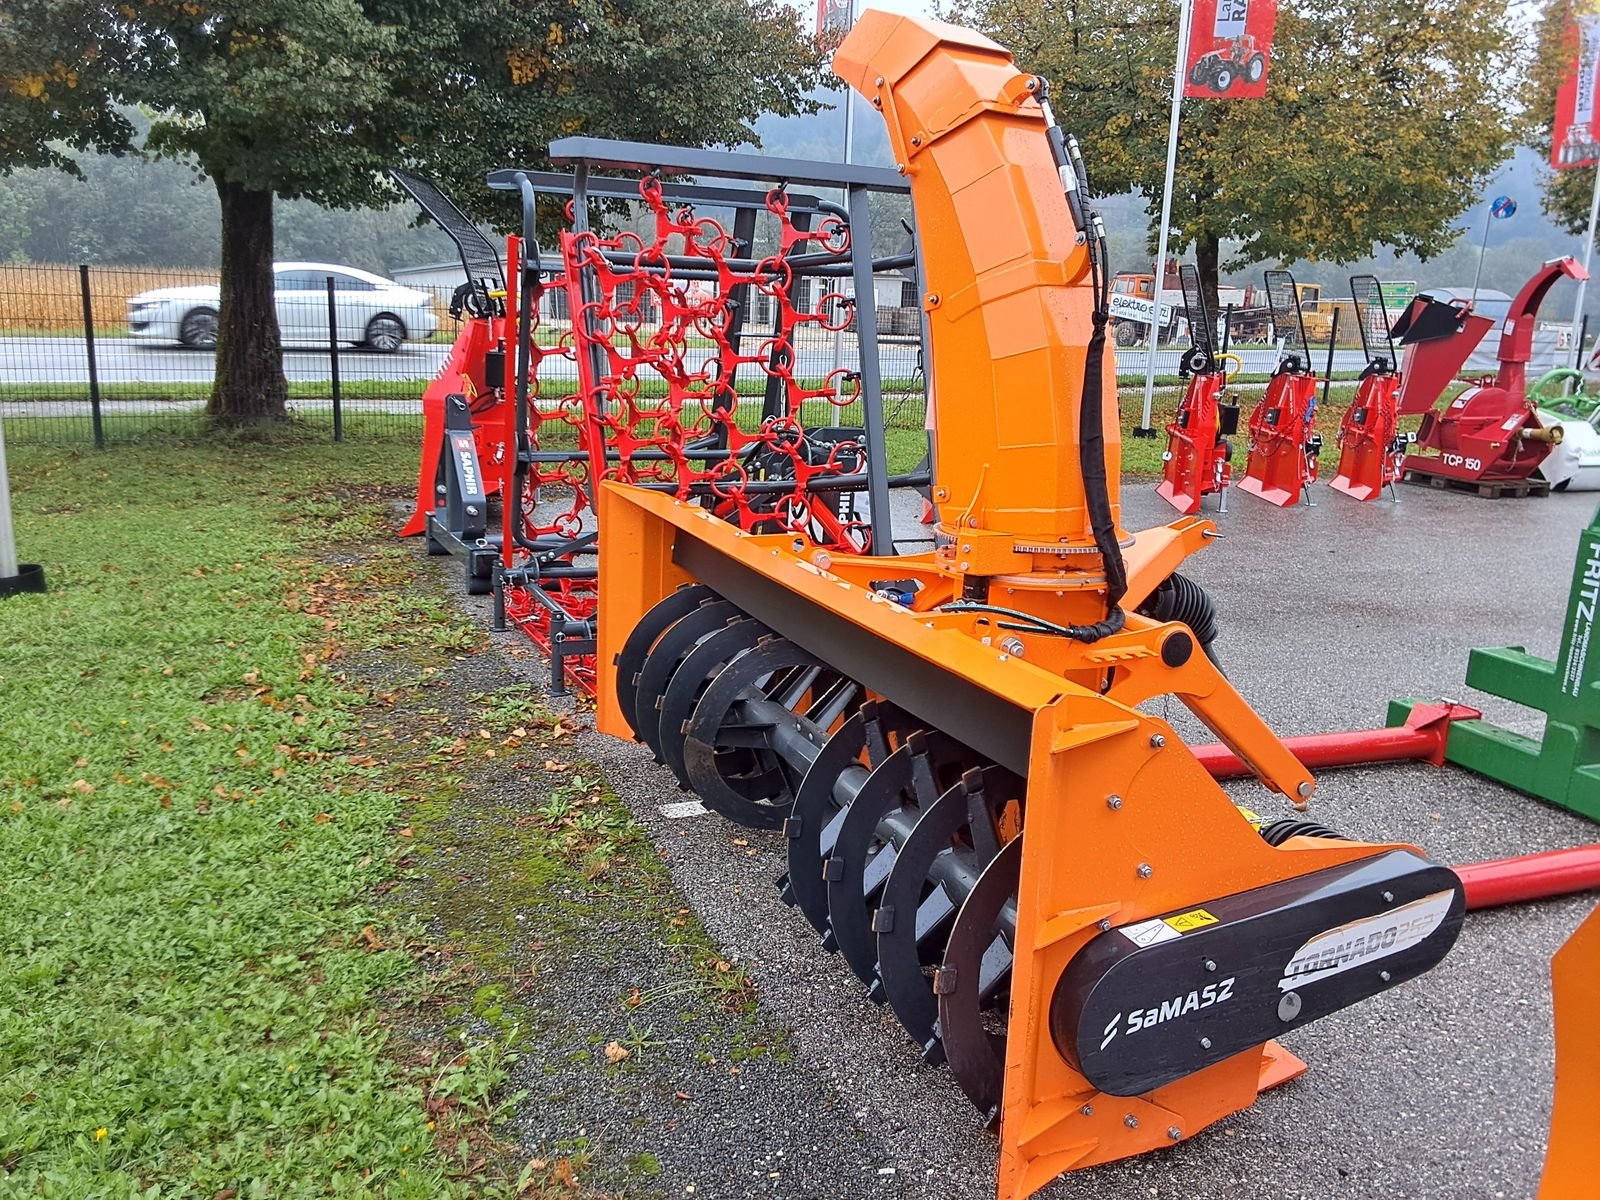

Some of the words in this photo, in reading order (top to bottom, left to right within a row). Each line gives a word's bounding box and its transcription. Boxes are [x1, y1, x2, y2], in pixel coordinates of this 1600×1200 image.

[1217, 0, 1232, 21] La
[460, 451, 478, 495] SAPHIR
[1442, 453, 1463, 467] TCP
[1465, 459, 1481, 471] 150
[1125, 977, 1236, 1035] SaMASZ
